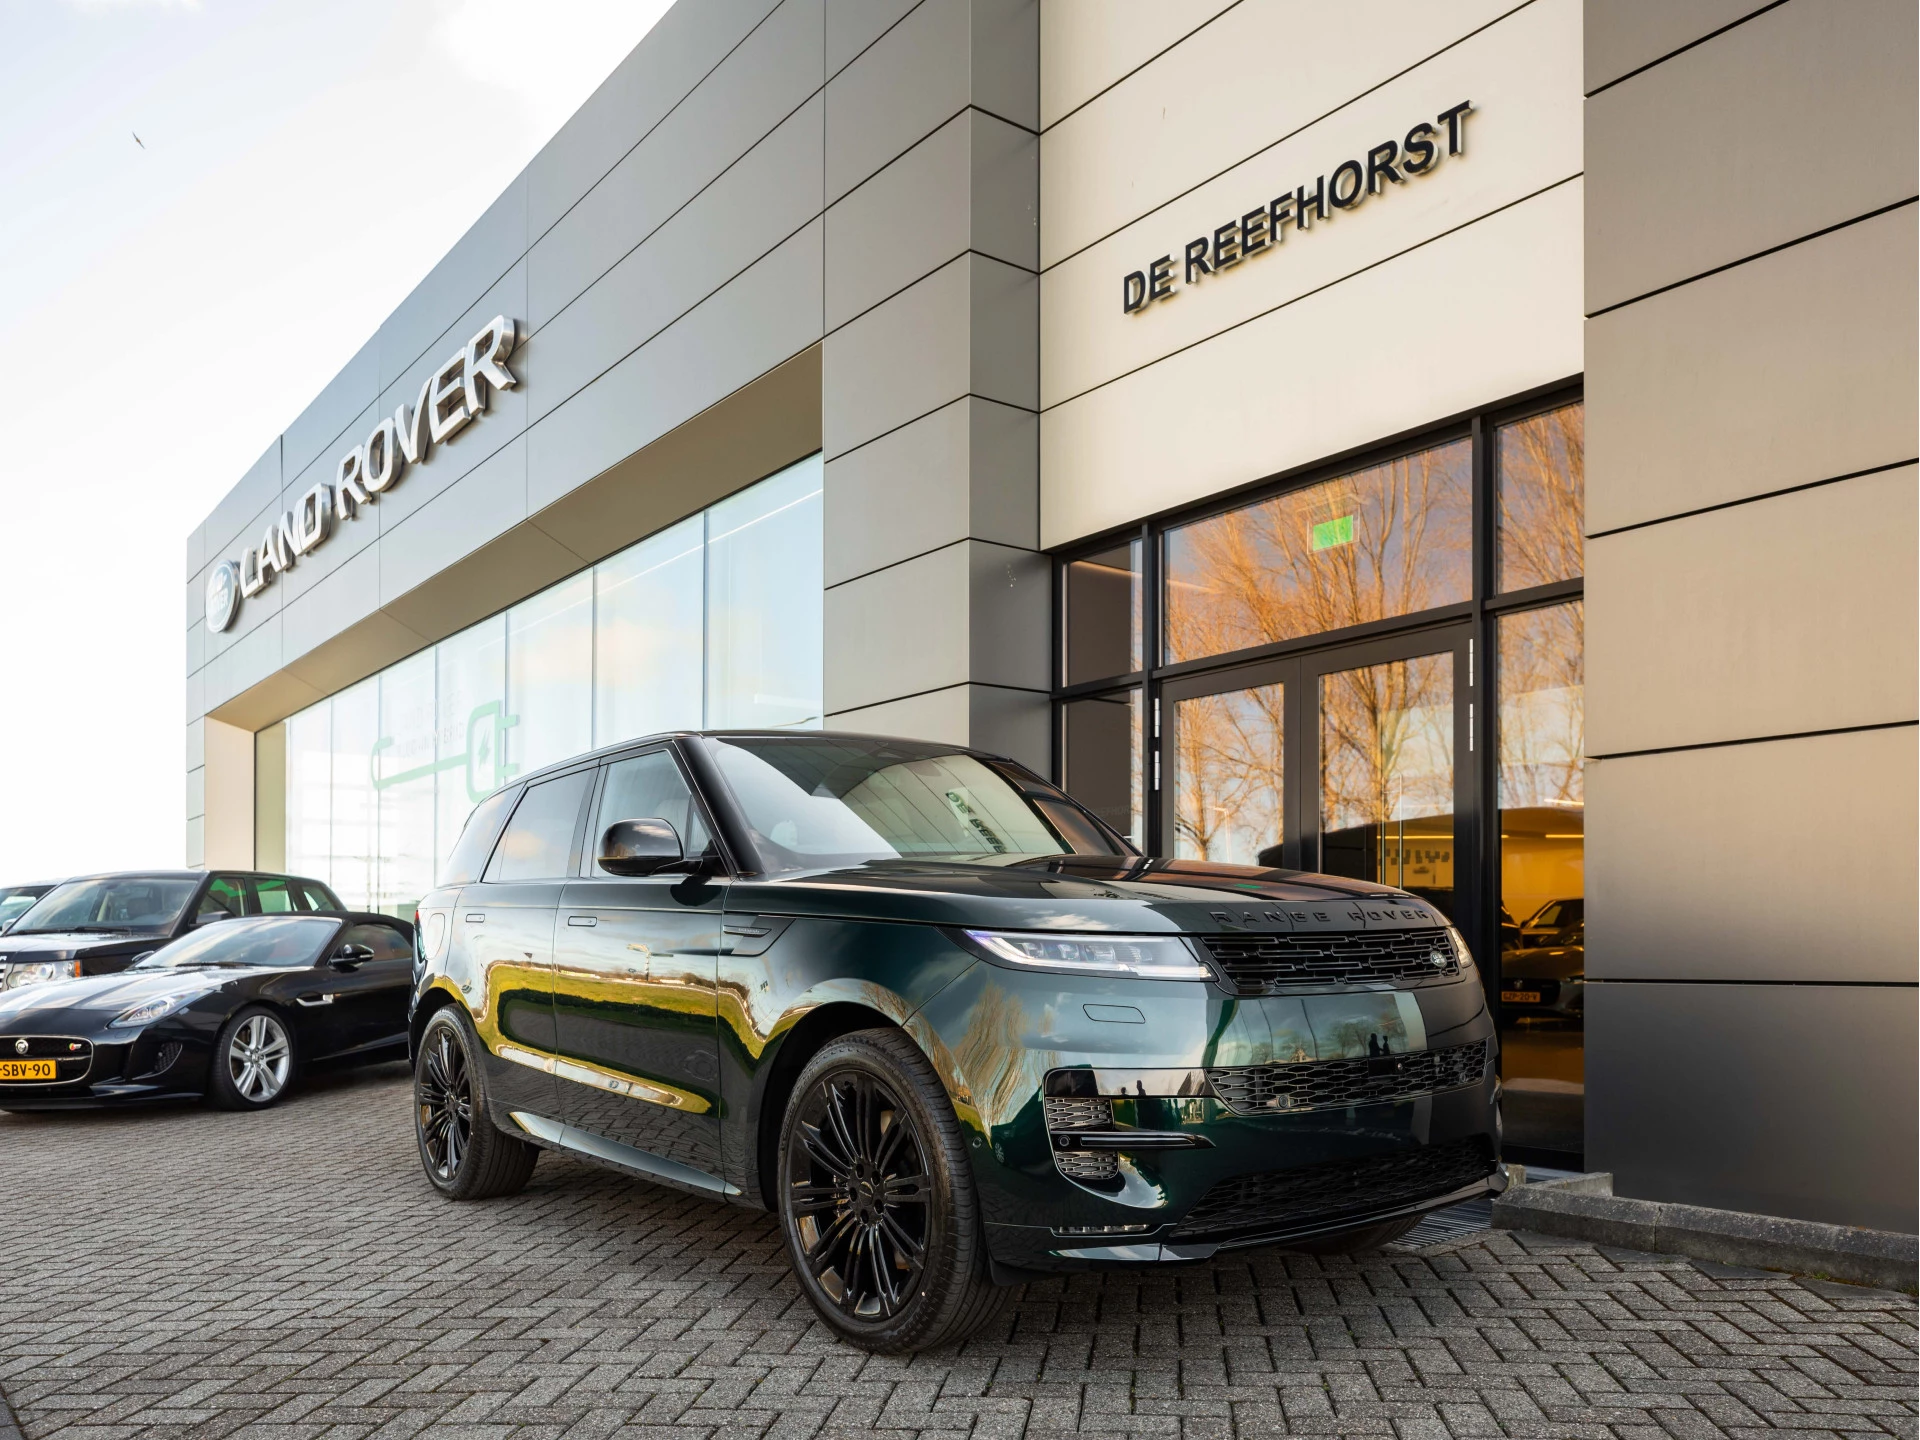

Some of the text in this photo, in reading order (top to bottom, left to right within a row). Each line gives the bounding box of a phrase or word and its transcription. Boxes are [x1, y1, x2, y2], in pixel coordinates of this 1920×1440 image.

[1124, 100, 1474, 315] DE REEFHORST
[239, 314, 517, 599] LAND ROVER
[1209, 910, 1429, 923] RANGE ROVER
